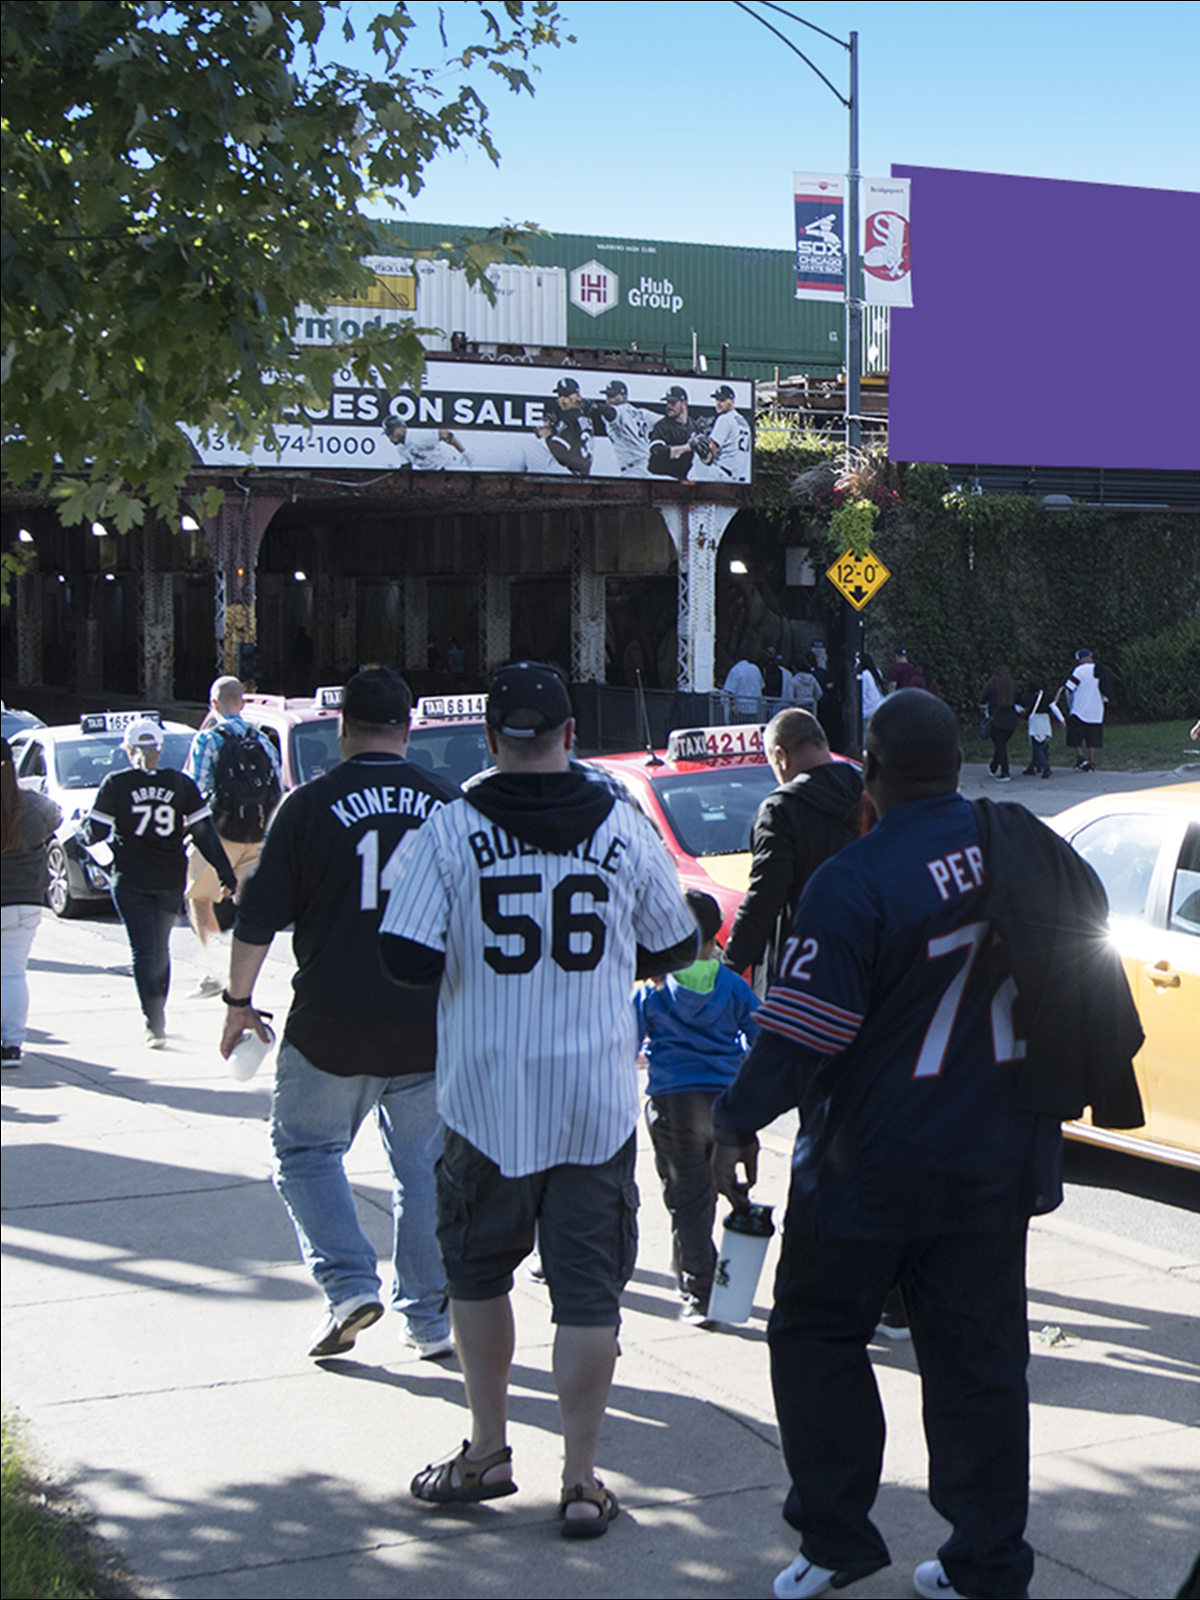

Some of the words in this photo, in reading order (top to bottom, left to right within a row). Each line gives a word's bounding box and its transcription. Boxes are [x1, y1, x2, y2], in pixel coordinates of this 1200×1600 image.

[798, 240, 843, 256] SOX
[798, 255, 842, 266] CHICAGO
[640, 276, 674, 295] Hub
[628, 288, 684, 313] Group
[390, 396, 443, 423] ON
[453, 398, 545, 427] SALE
[324, 691, 342, 705] TAX
[424, 700, 444, 714] TAXI
[447, 698, 483, 714] 6614
[677, 734, 706, 757] TAXI
[706, 731, 762, 754] 4214
[131, 787, 175, 804] ABREU
[131, 805, 175, 836] 79
[469, 824, 627, 874] BULE
[927, 845, 984, 900] PER
[480, 874, 609, 974] 56
[780, 936, 819, 981] 72
